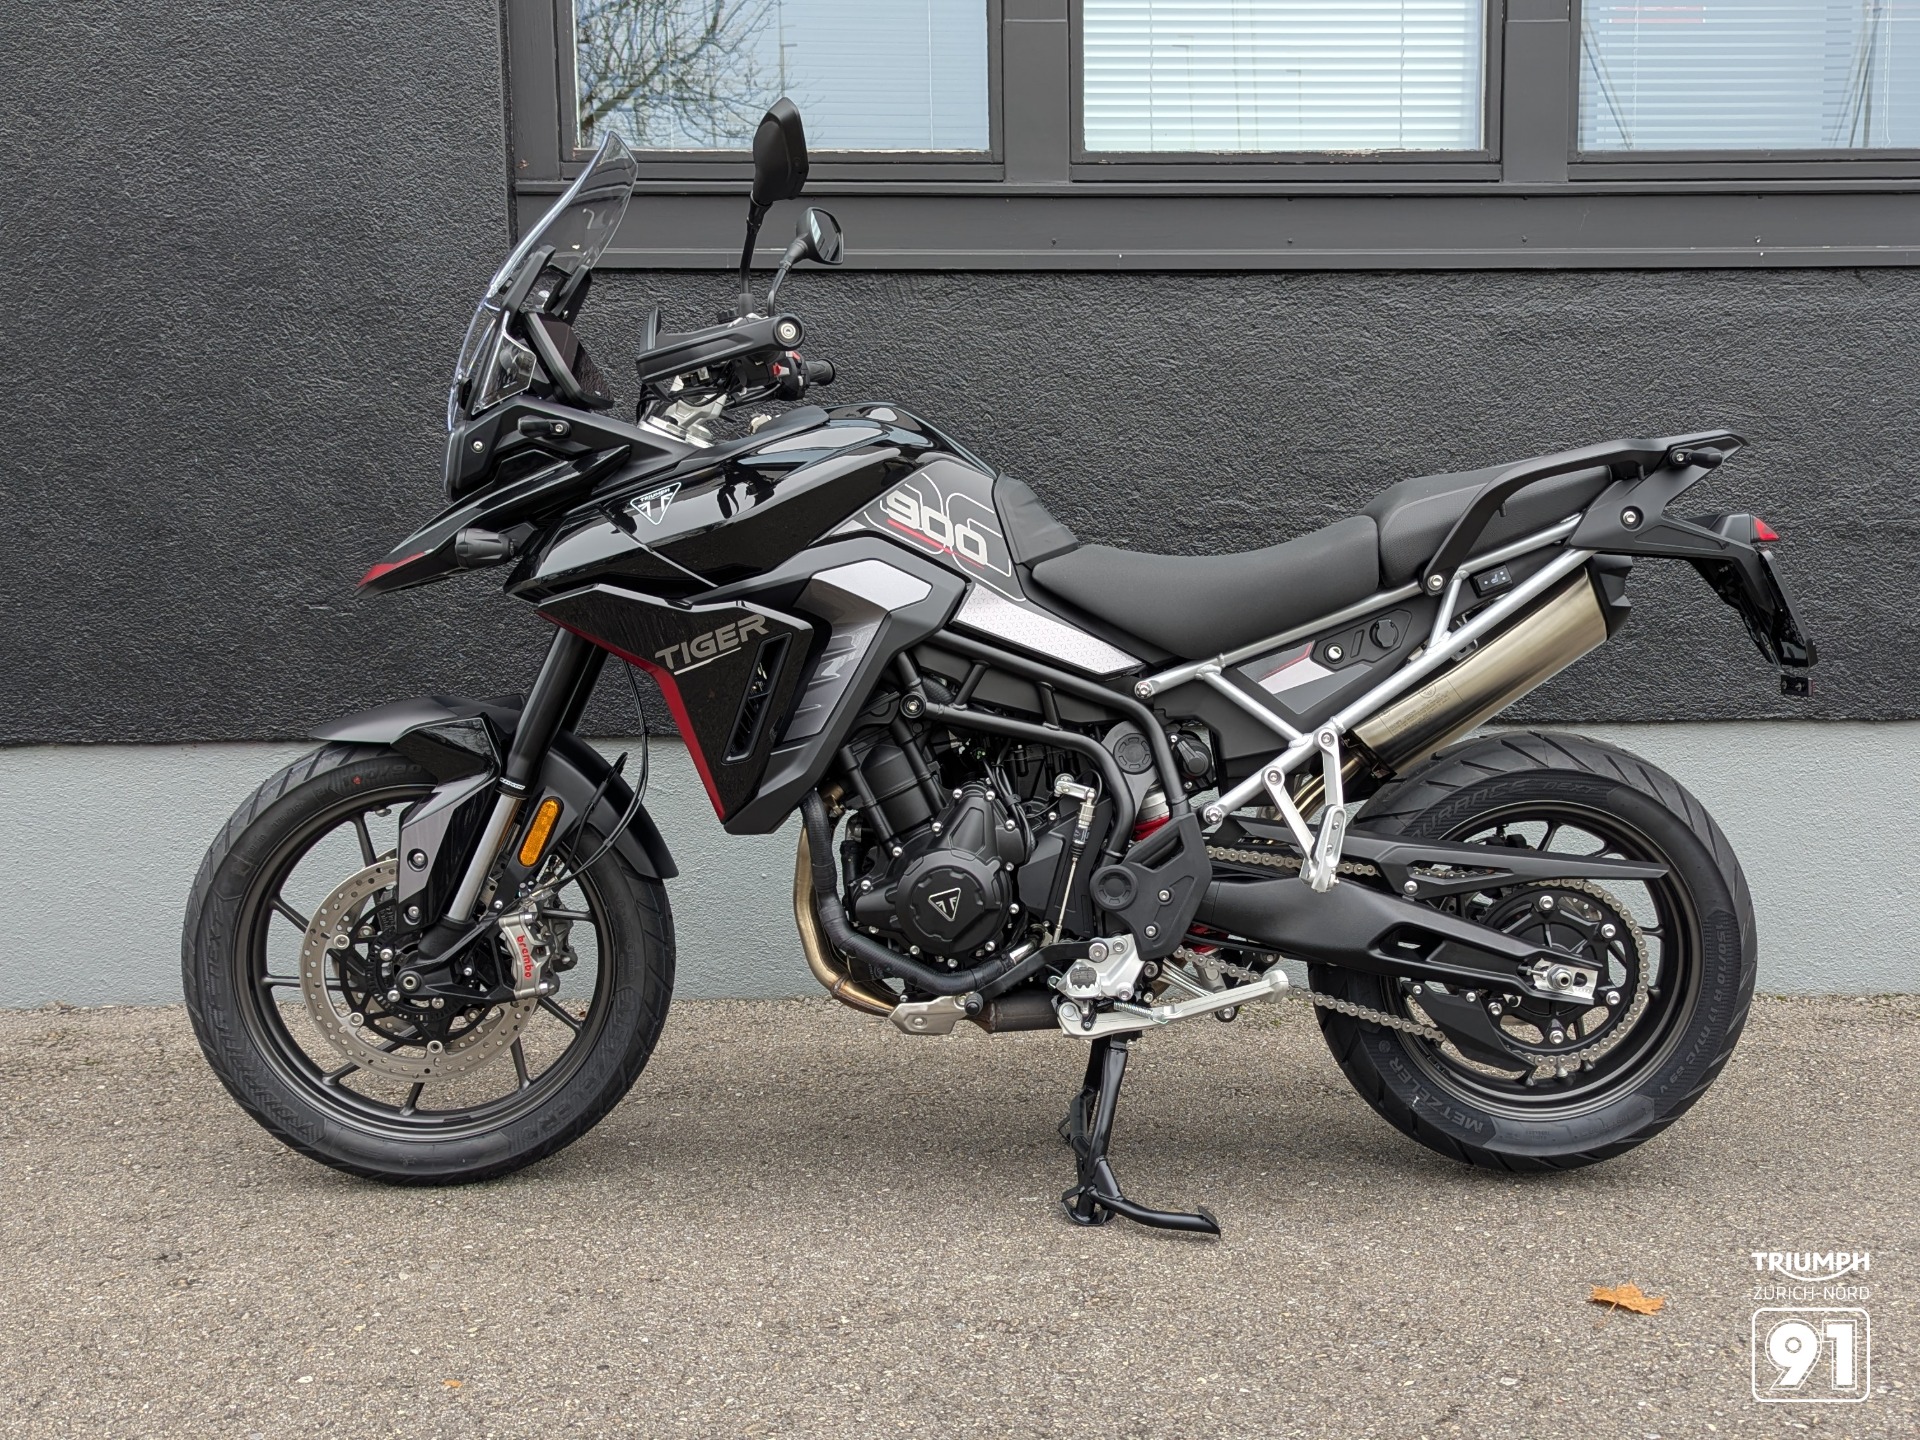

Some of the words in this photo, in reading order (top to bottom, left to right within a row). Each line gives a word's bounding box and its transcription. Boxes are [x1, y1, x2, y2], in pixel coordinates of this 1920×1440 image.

[886, 489, 988, 566] 900
[654, 613, 769, 669] TIGER
[516, 934, 534, 978] brembo
[1388, 1056, 1484, 1134] METZELER
